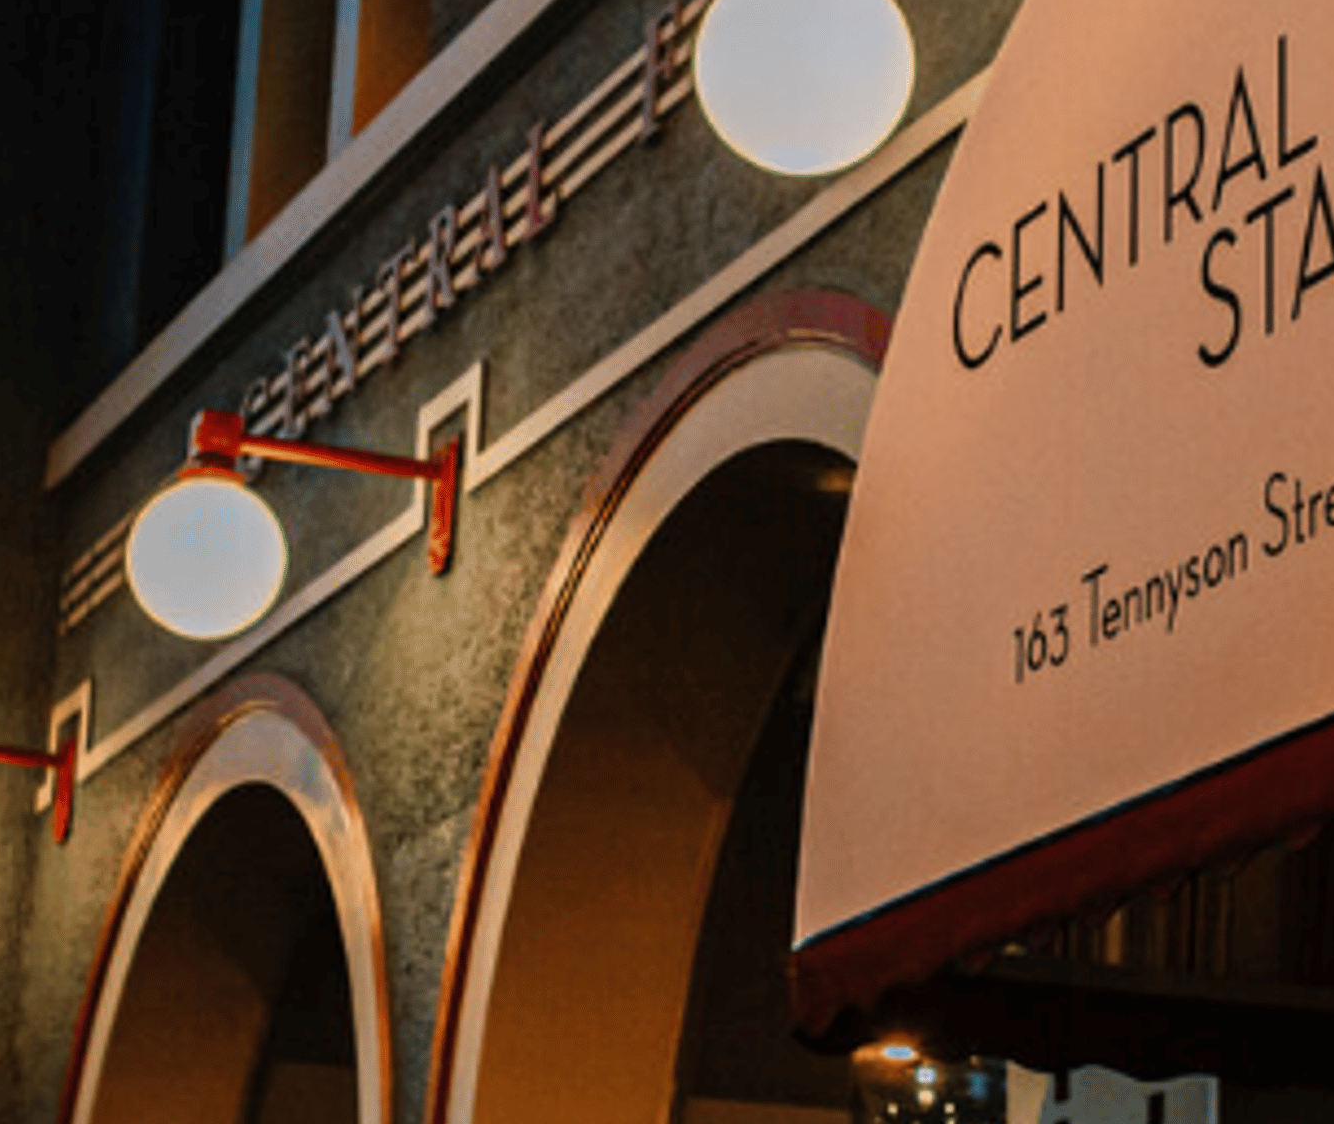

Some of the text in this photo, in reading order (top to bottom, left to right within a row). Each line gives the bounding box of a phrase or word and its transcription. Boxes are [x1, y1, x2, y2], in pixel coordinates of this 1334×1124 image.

[953, 38, 1319, 370] CENTRAL
[1012, 604, 1070, 684] 163
[1081, 532, 1250, 647] Tennyson
